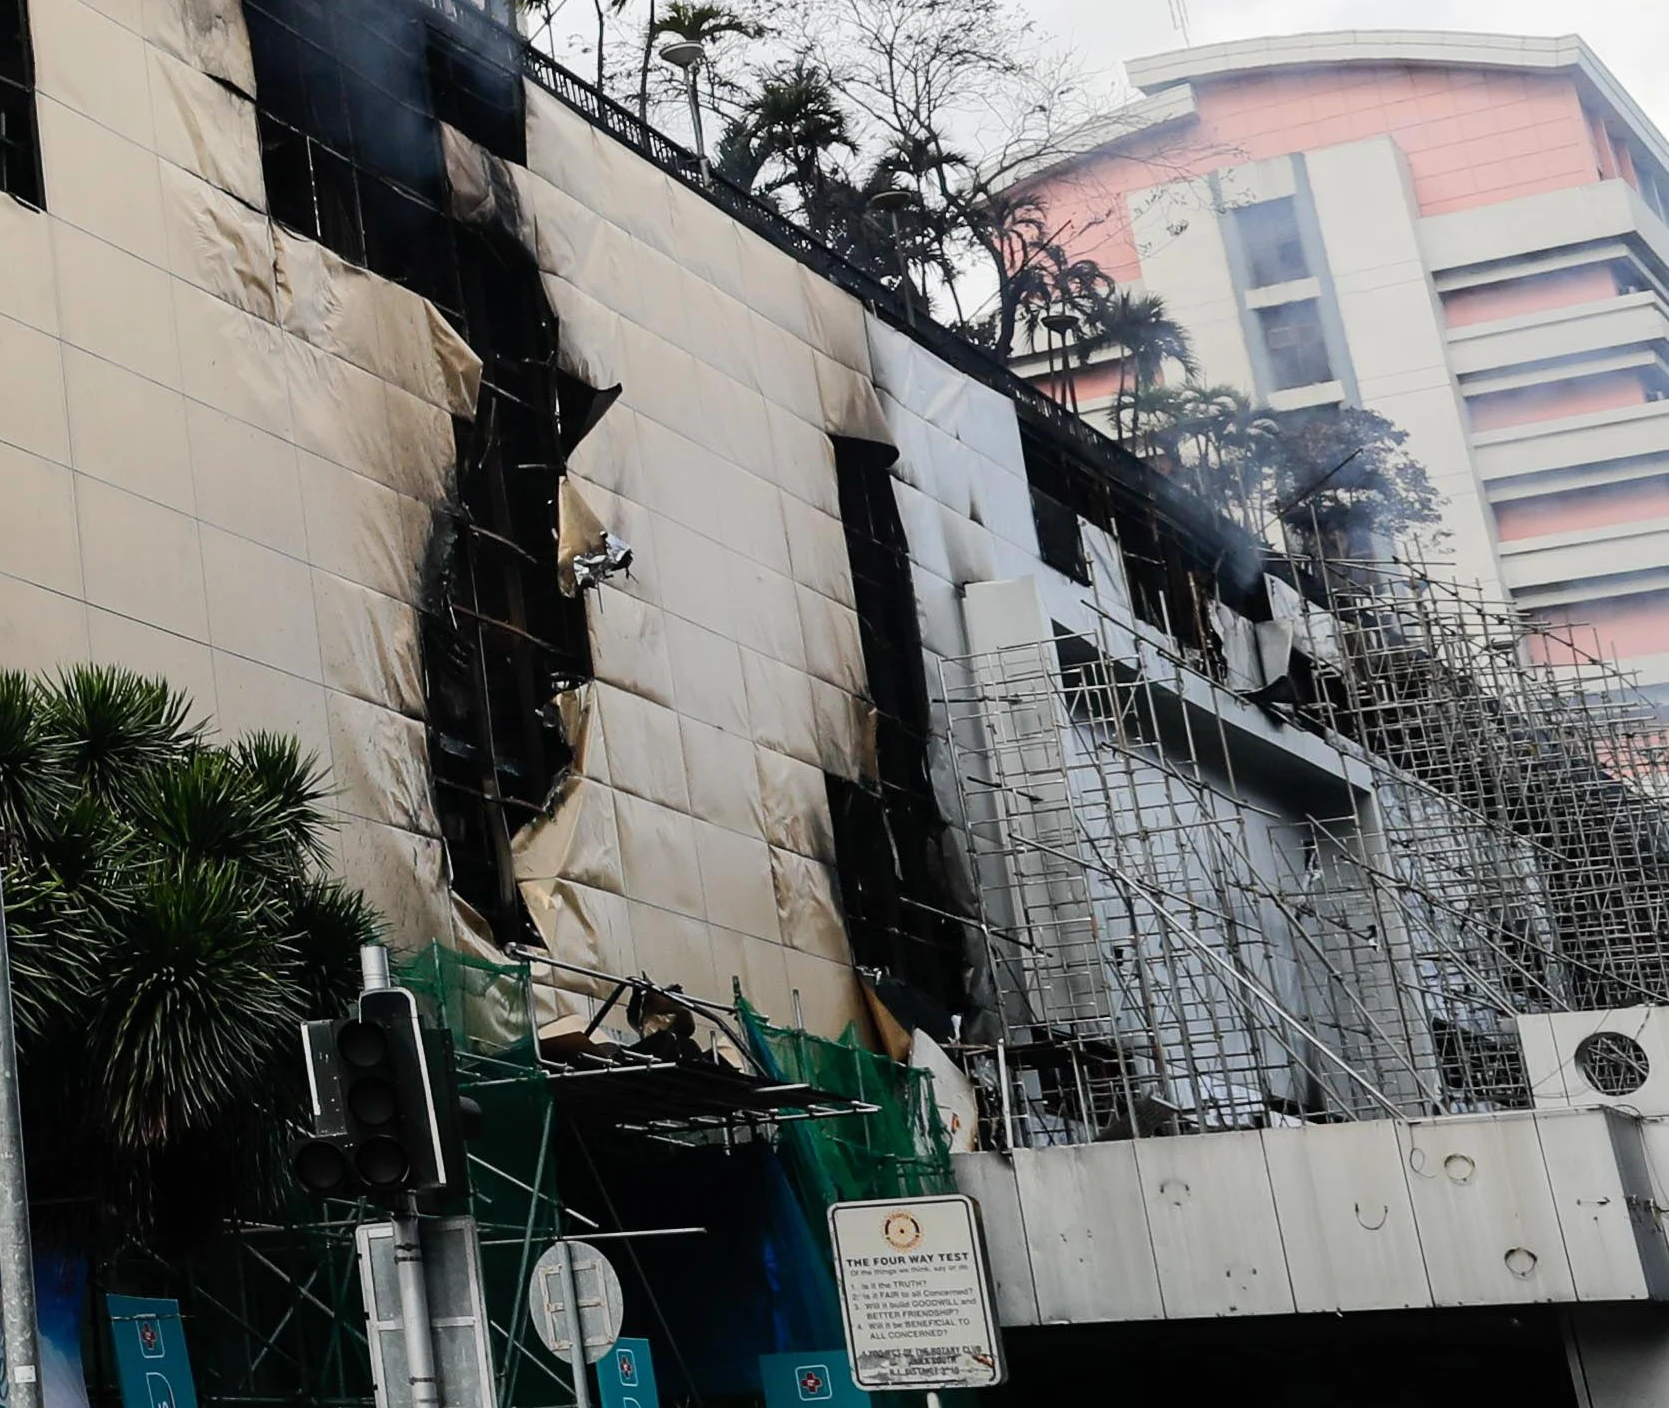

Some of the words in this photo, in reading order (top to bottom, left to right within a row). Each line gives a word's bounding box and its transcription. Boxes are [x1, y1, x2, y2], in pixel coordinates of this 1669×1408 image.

[846, 1259, 869, 1267] THE
[873, 1256, 905, 1266] FOUR
[908, 1254, 934, 1264] WAY
[938, 1252, 968, 1262] TEST
[893, 1280, 927, 1288] TRUTH?
[879, 1291, 900, 1299] FAIR
[911, 1299, 959, 1308] GOODWILL
[866, 1311, 901, 1320] BETTER
[902, 1308, 959, 1318] FRIENDSHIP?
[905, 1318, 956, 1328] BENEFICIAL
[870, 1332, 886, 1340] ALL
[888, 1330, 948, 1340] CONCERNED?
[962, 1345, 982, 1354] CLUB
